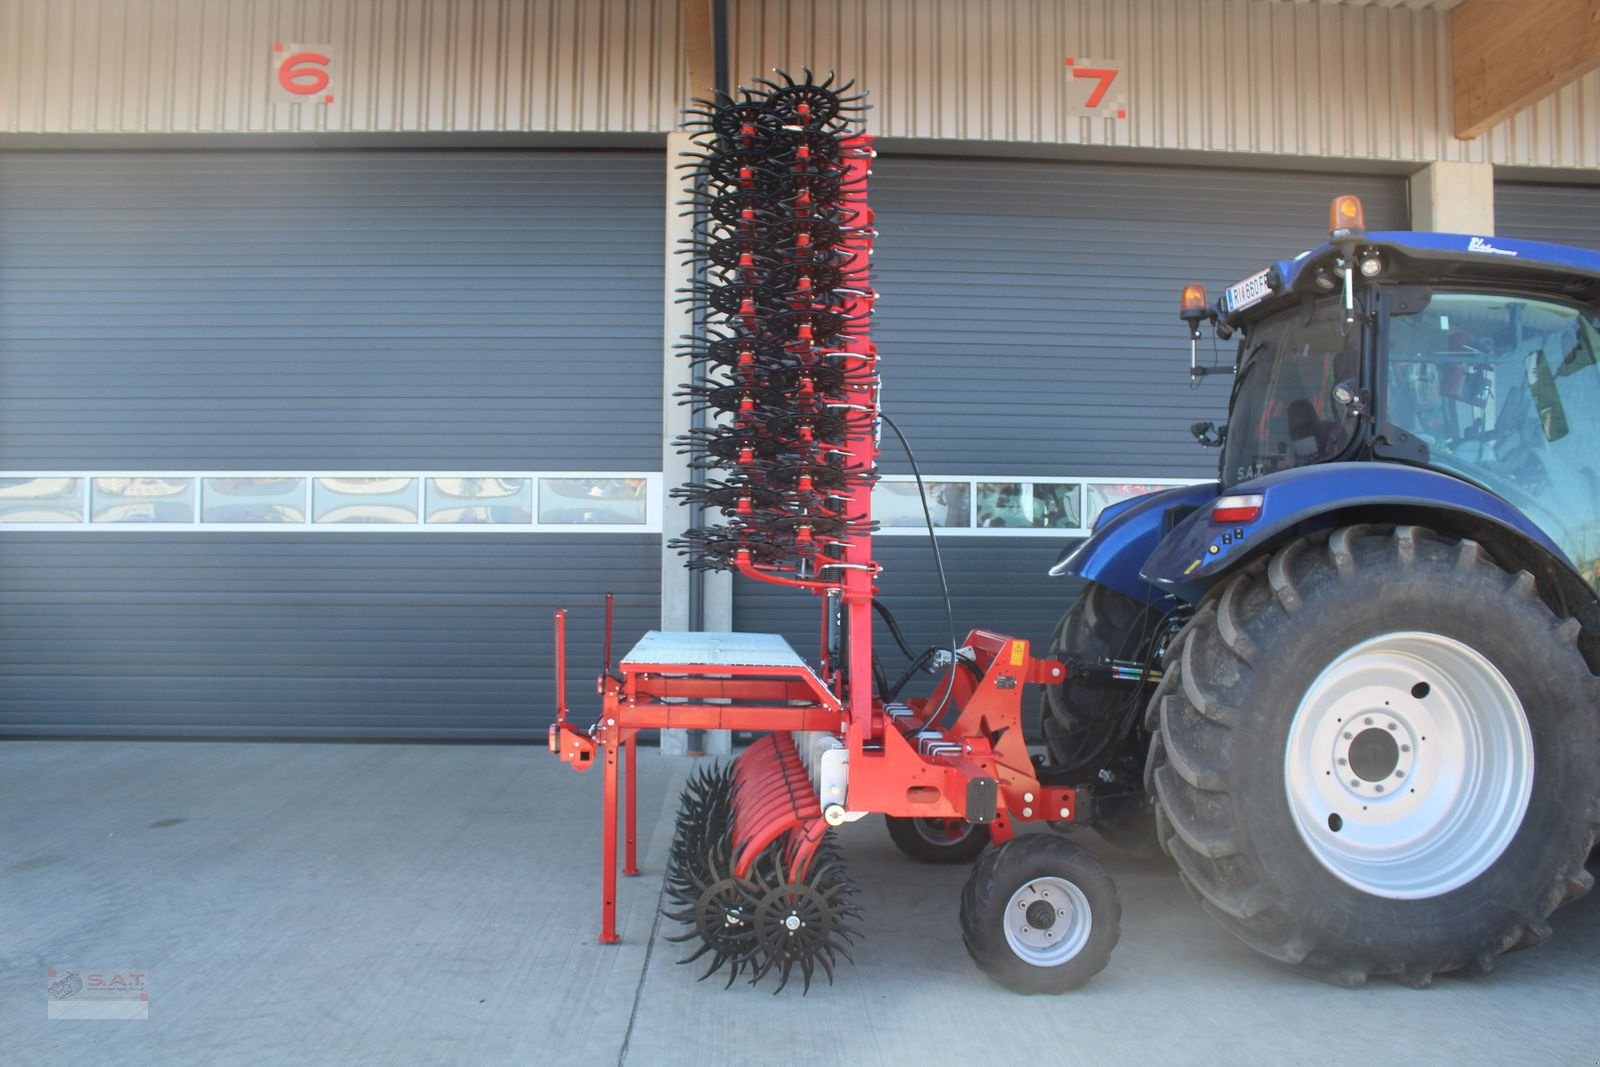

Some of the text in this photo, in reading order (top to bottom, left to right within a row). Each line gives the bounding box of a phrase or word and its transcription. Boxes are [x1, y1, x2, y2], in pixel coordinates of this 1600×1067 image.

[279, 53, 330, 95] 6
[1072, 68, 1118, 108] 7
[1246, 279, 1259, 299] 660
